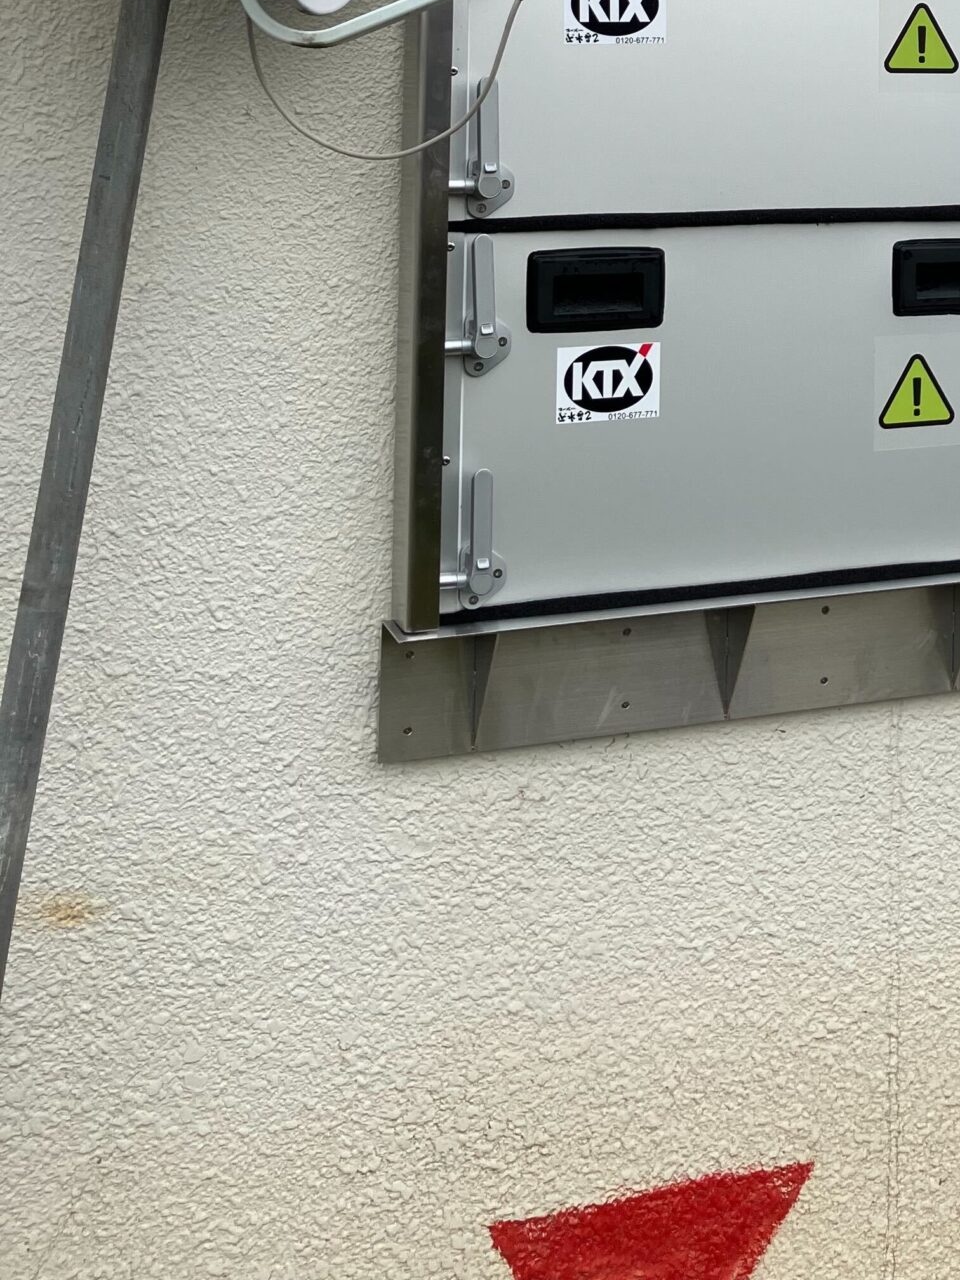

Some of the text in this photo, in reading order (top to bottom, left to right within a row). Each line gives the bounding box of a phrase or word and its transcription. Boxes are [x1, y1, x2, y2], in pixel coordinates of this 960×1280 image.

[615, 36, 665, 45] 0120-677-771
[572, 343, 654, 401] KTX
[607, 410, 658, 420] 0120-677-771
